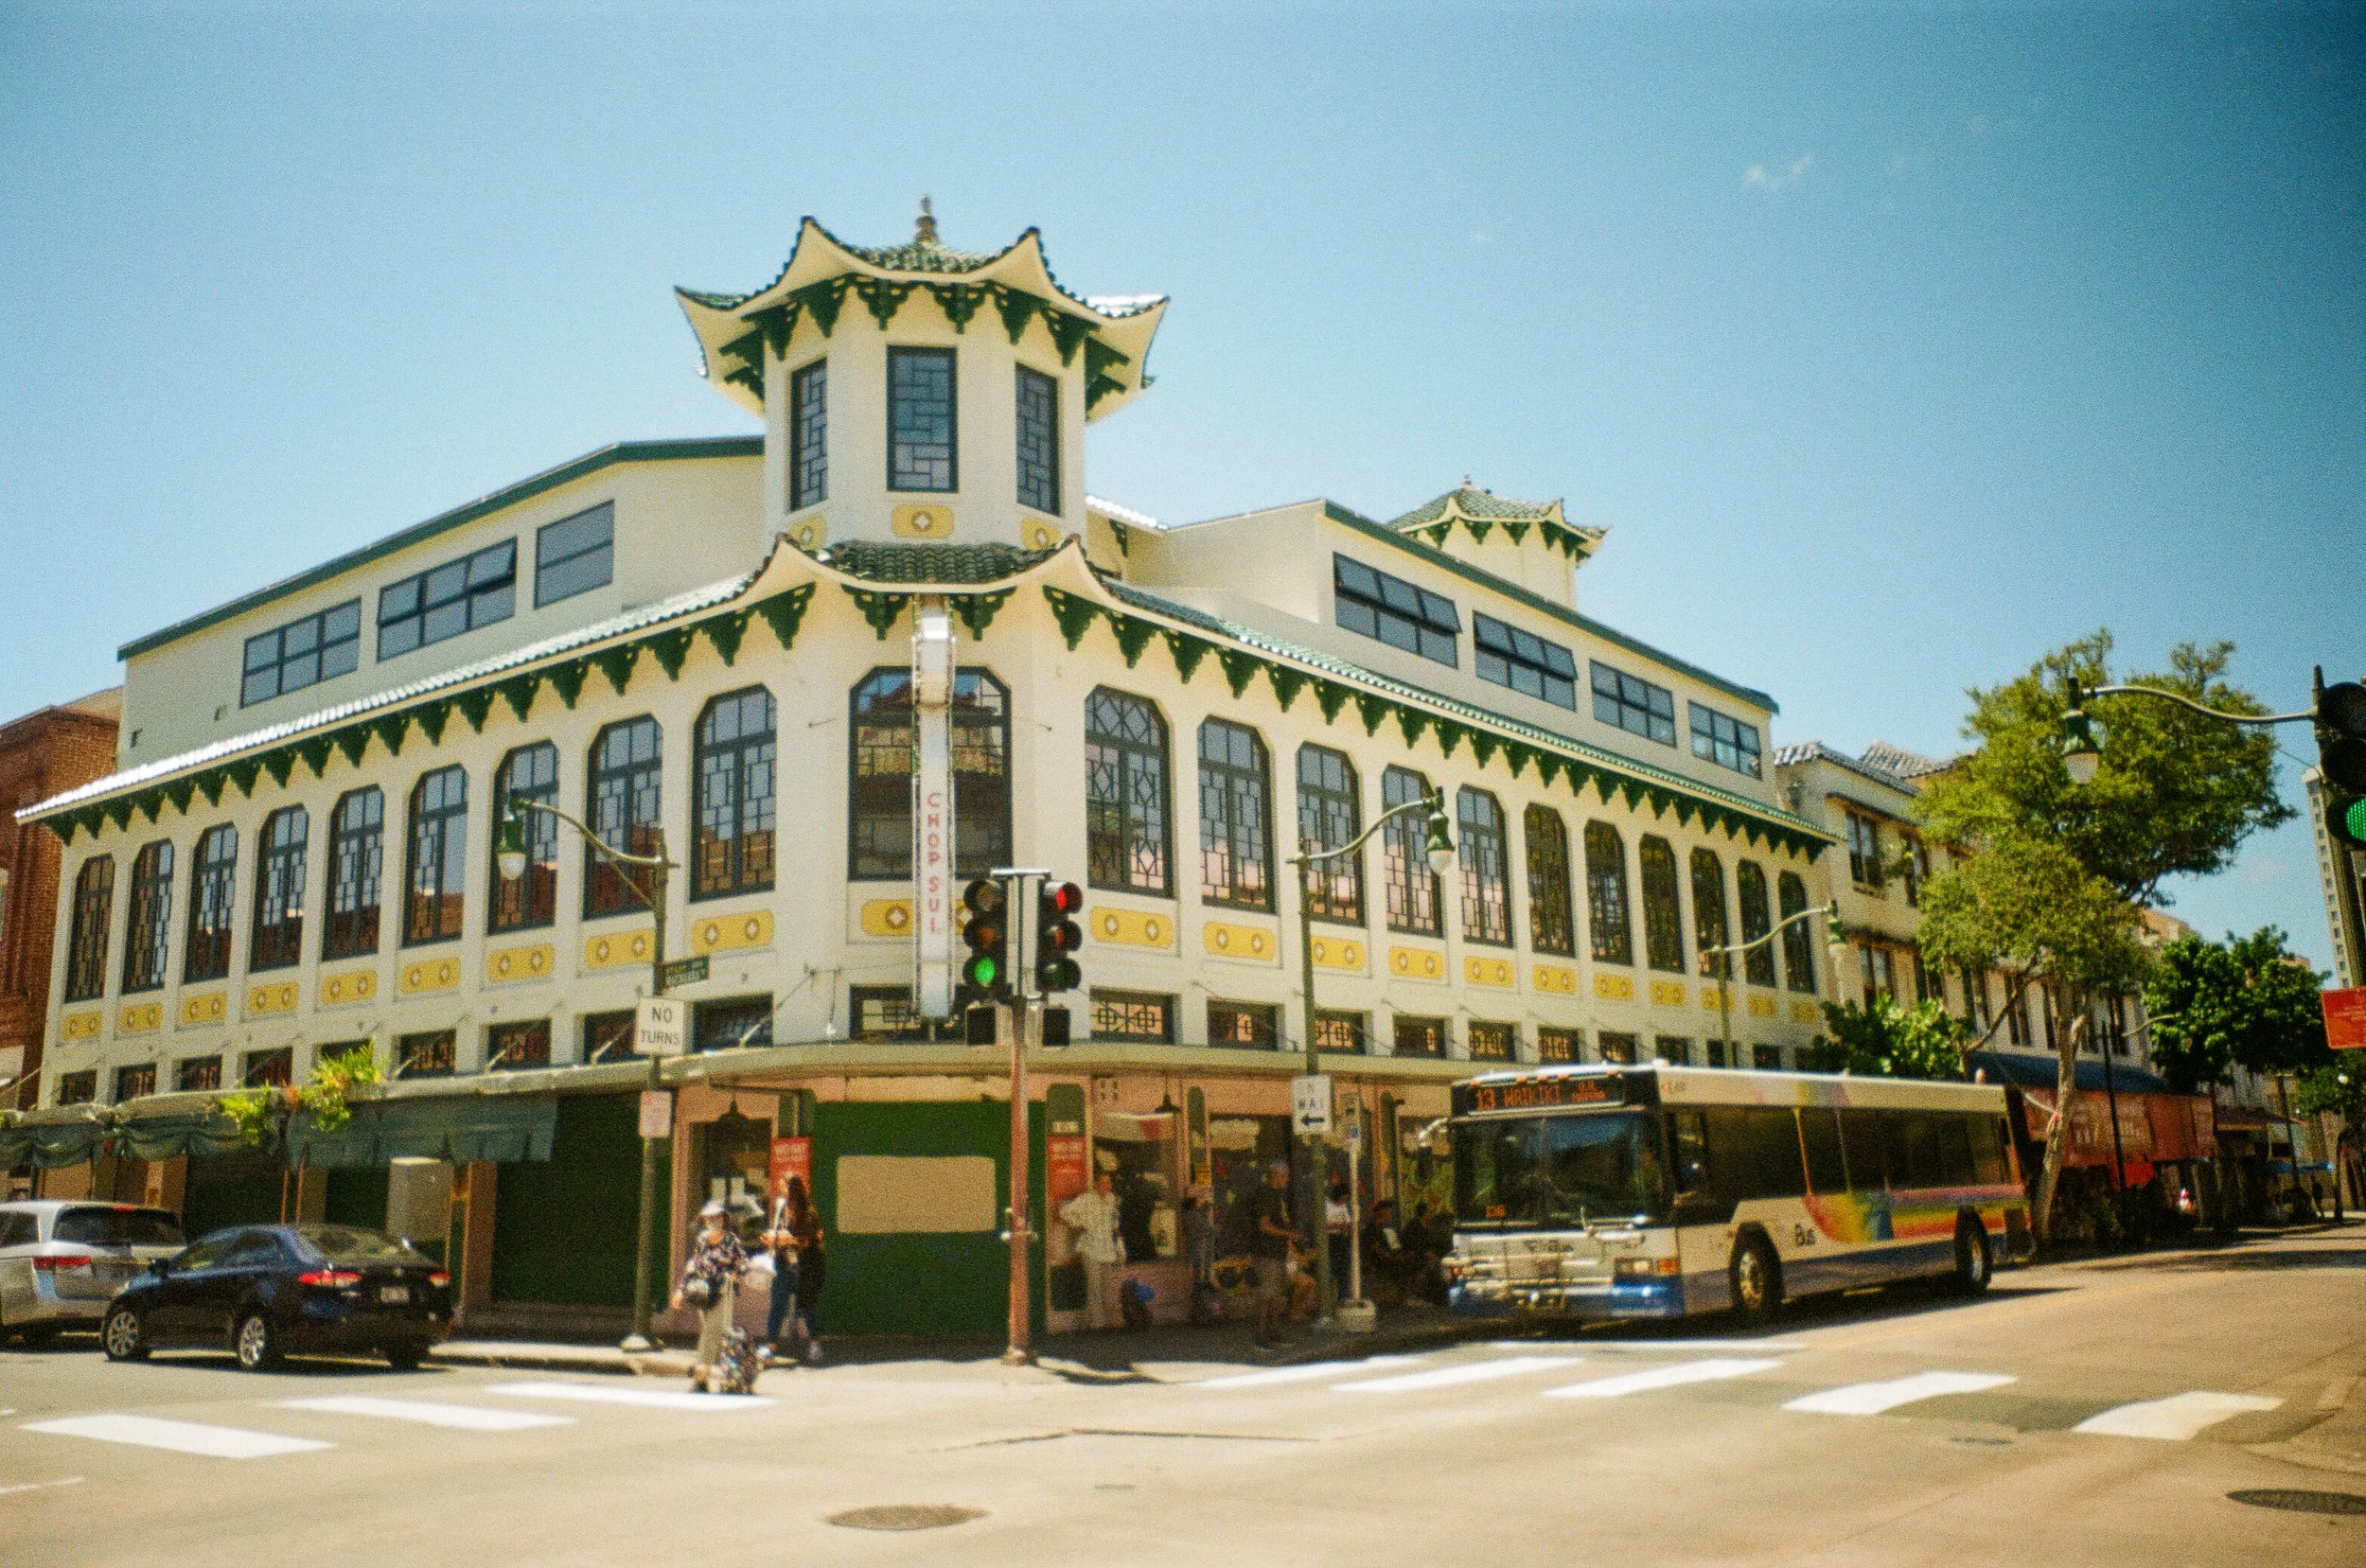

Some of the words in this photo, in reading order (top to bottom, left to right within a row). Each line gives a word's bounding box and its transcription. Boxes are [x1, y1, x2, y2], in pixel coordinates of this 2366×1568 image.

[927, 791, 941, 866] CHOP
[652, 1007, 673, 1023] NO
[641, 1030, 680, 1046] TURNS
[1476, 1088, 1496, 1110] 13
